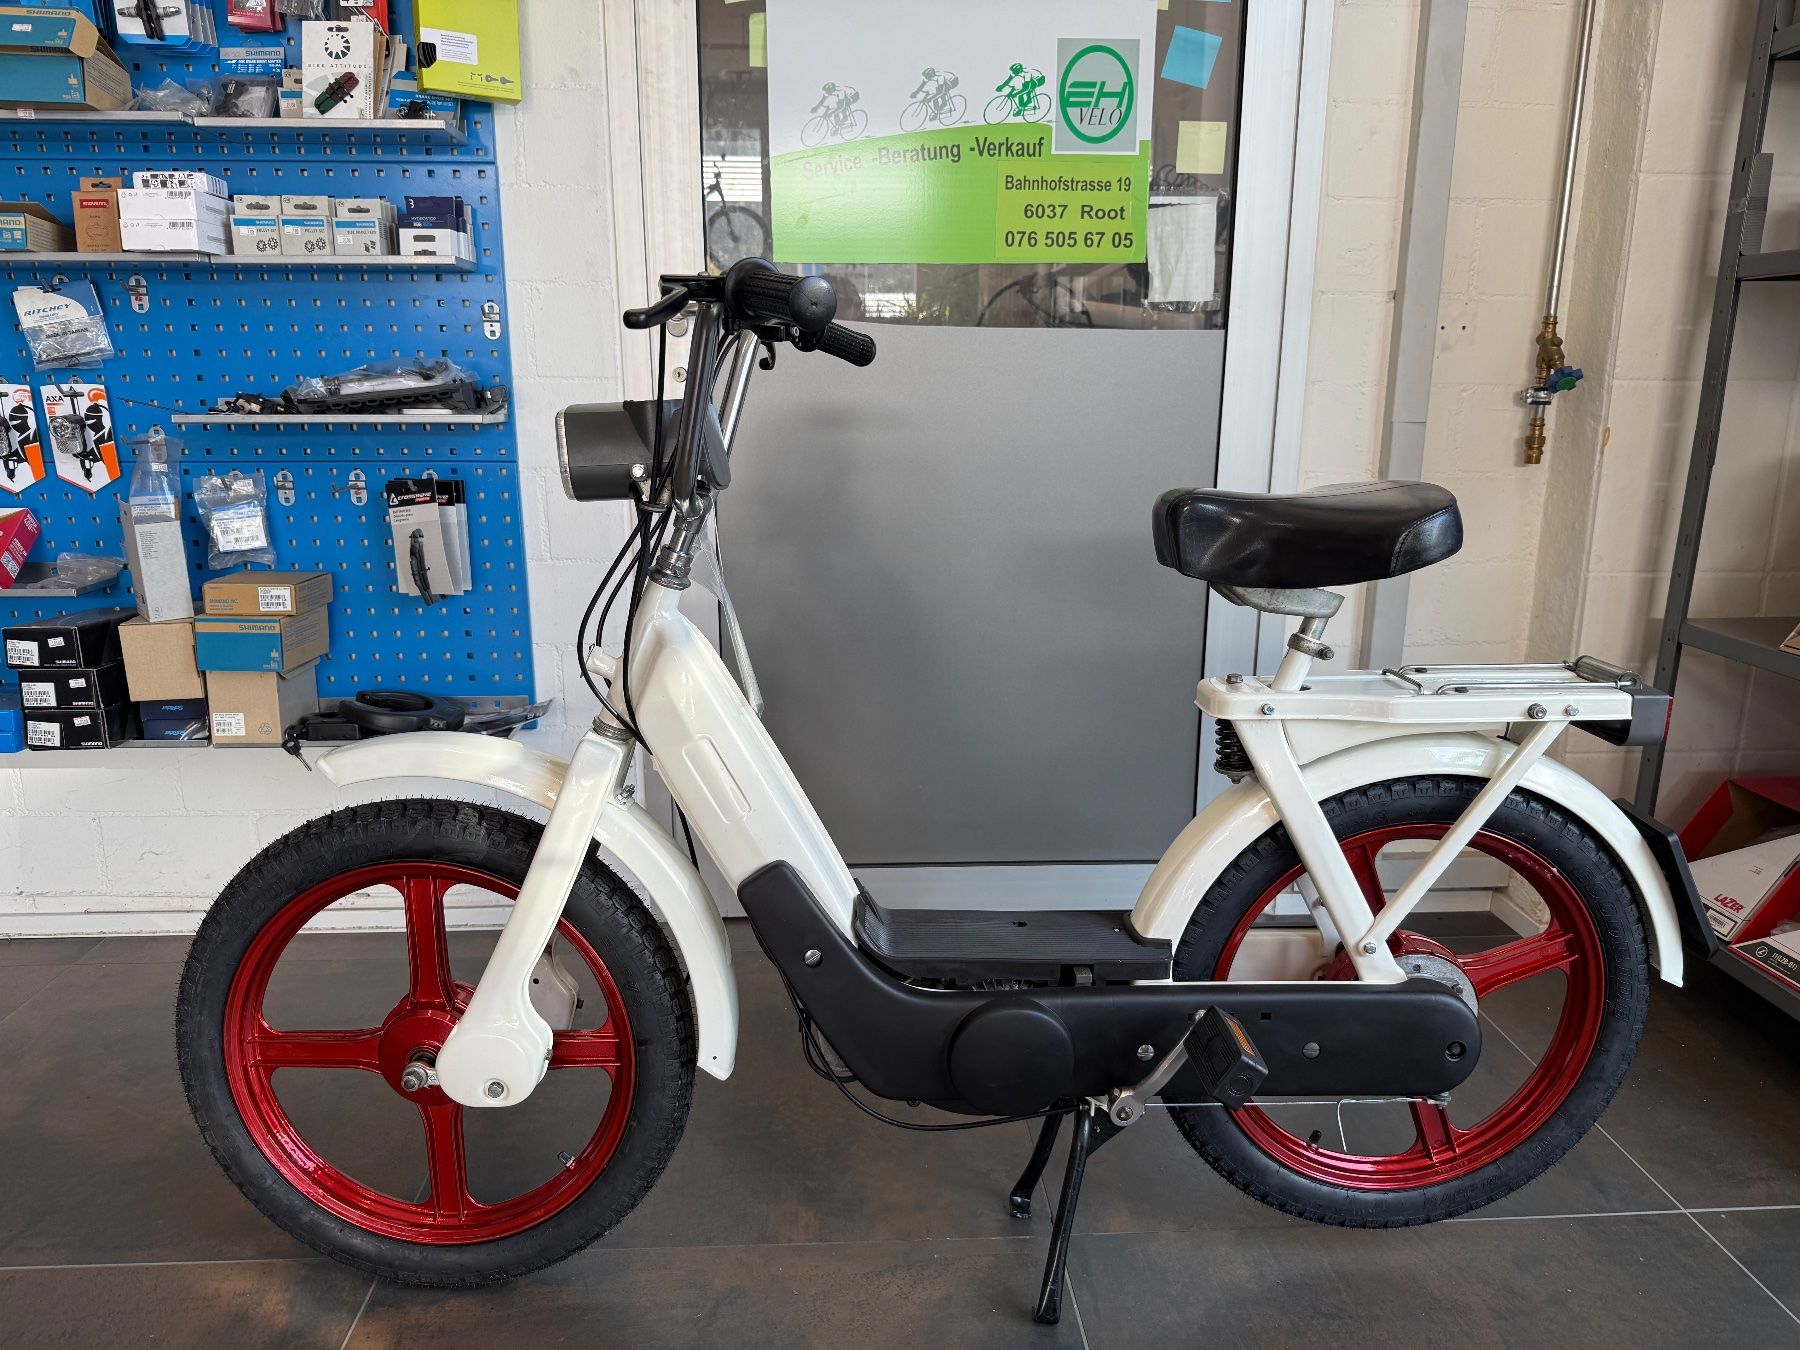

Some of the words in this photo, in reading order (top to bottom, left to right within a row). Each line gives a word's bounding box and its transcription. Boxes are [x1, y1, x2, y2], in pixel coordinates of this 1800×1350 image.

[1078, 107, 1123, 126] VELO
[802, 155, 862, 181] Service
[969, 136, 1045, 159] -Verkauf
[1005, 175, 1112, 193] Bahnhofstrasse
[1116, 176, 1132, 193] 19
[1024, 204, 1069, 220] 6037
[1080, 204, 1126, 220] Root
[1005, 231, 1038, 248] 076
[1044, 231, 1078, 249] 505
[1083, 231, 1106, 249] 67
[1111, 231, 1134, 249] 05
[23, 302, 72, 317] RITCHEY
[45, 395, 65, 403] AXA
[1714, 894, 1744, 913] LAZER
